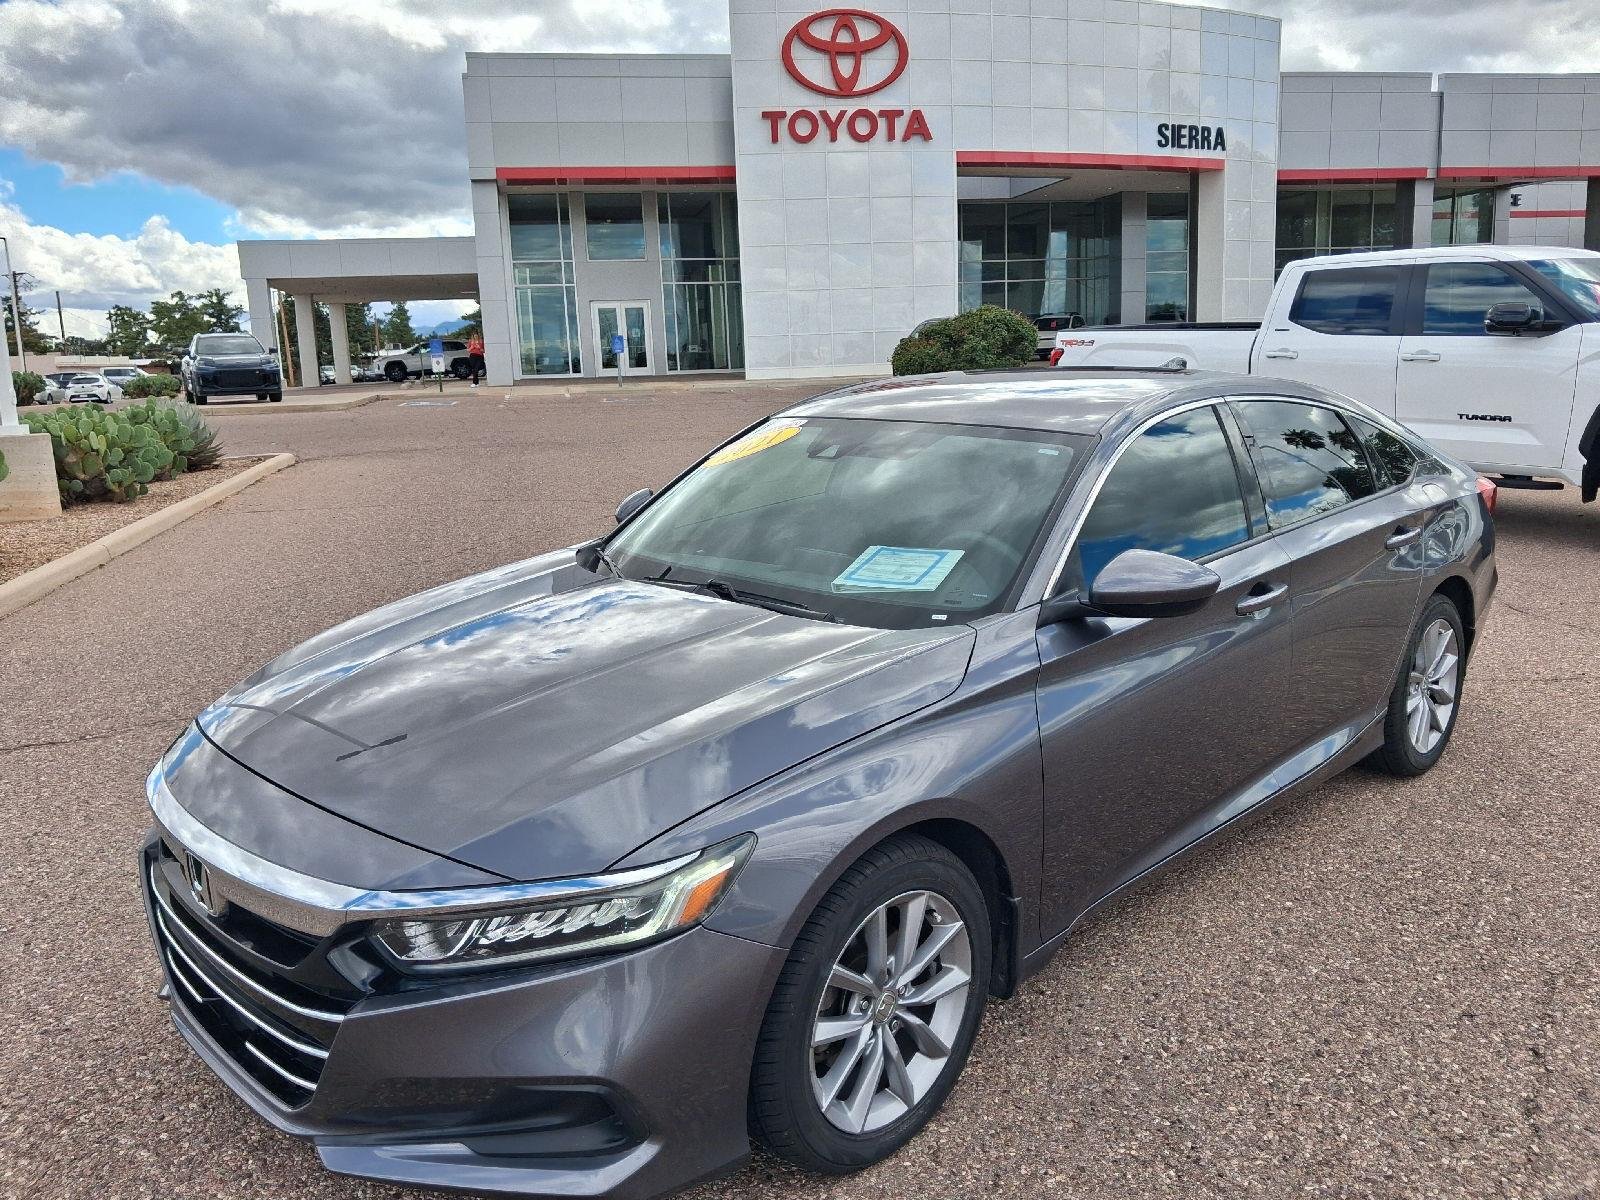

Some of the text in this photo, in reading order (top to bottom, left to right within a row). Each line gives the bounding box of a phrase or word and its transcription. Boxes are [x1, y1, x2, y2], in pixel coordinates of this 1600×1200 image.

[761, 108, 933, 144] TOYOTA
[1157, 122, 1227, 152] SIERRA
[1456, 413, 1513, 423] TUNDRA
